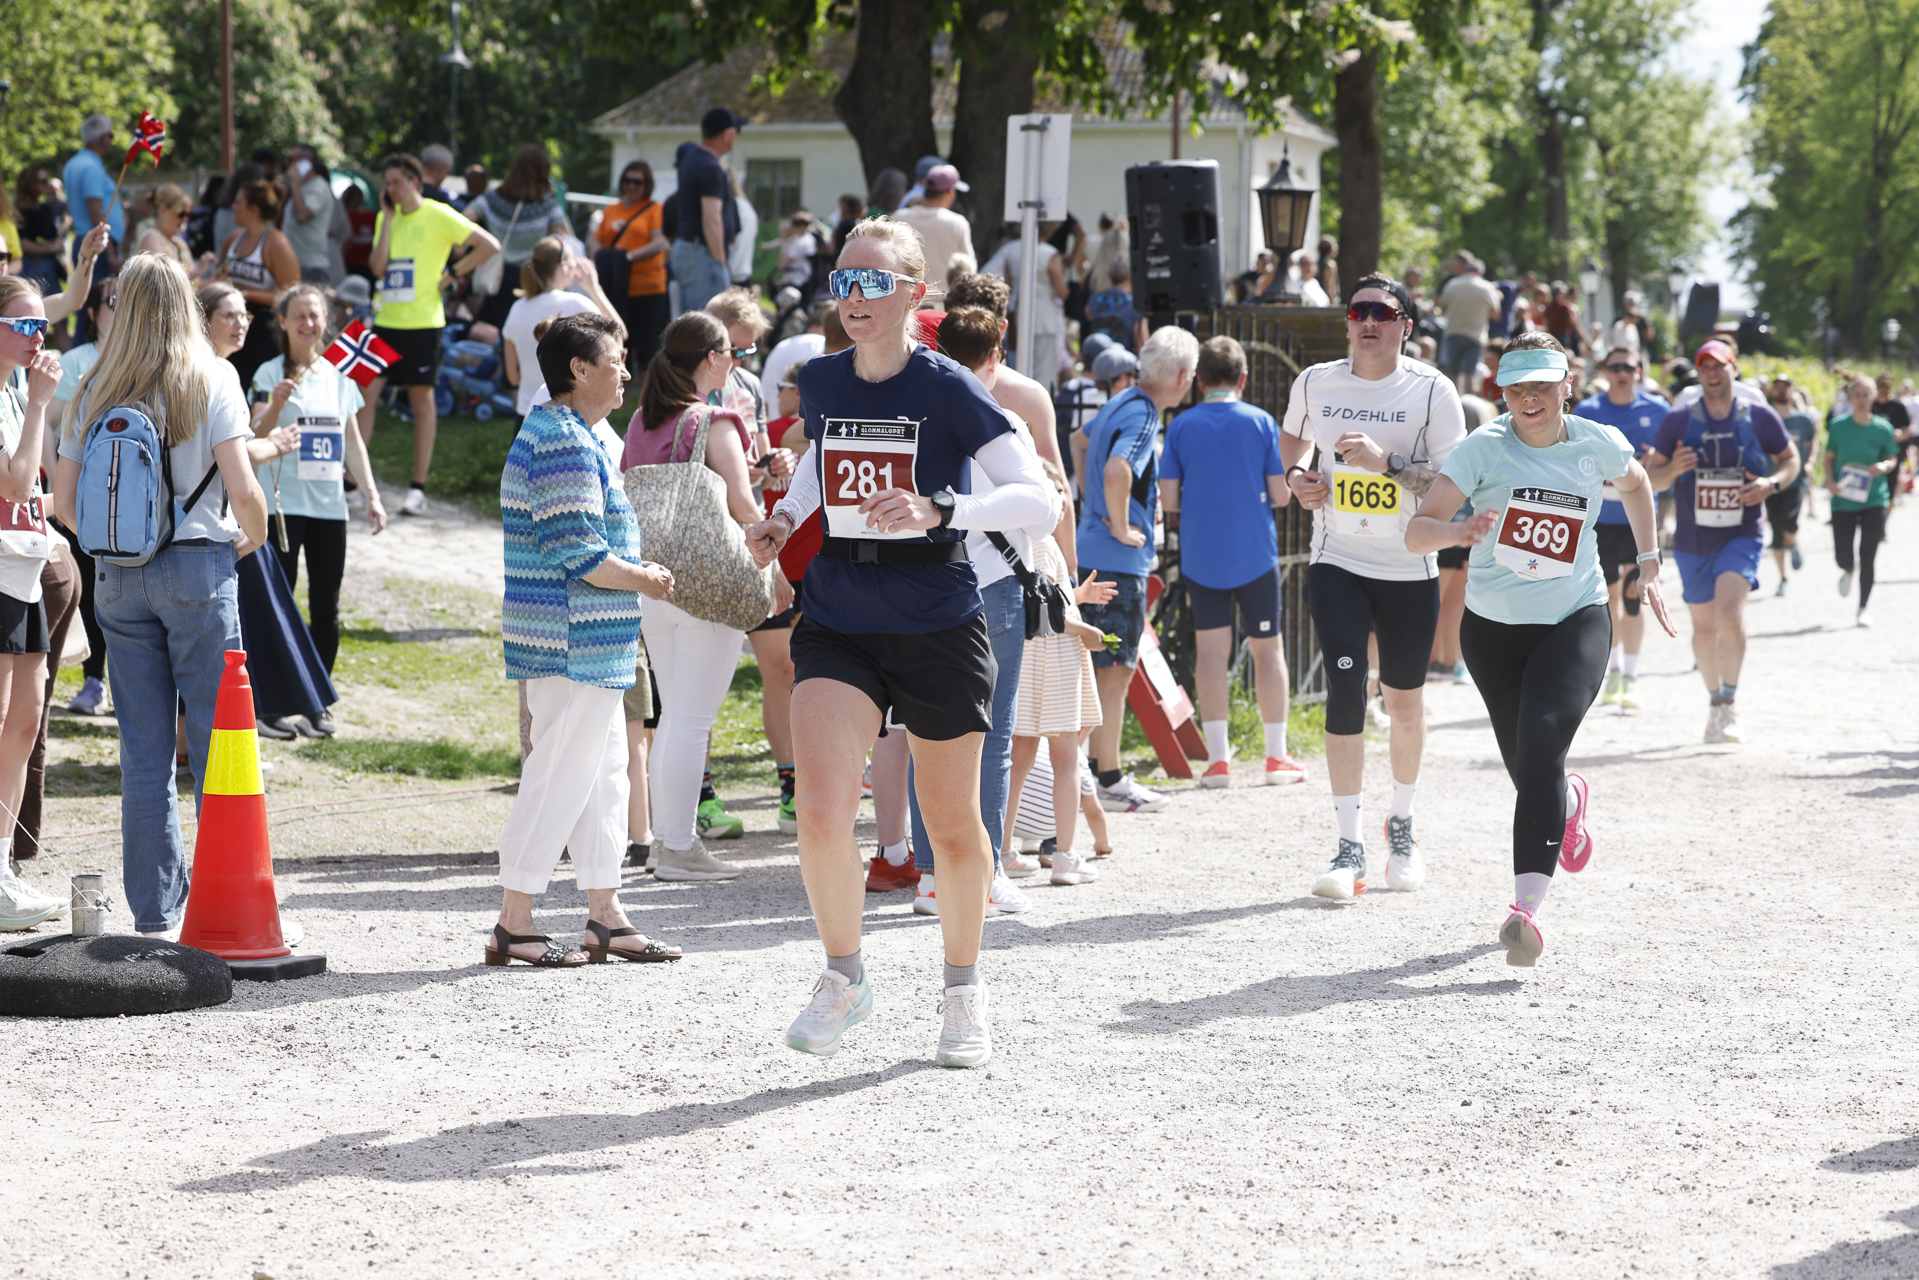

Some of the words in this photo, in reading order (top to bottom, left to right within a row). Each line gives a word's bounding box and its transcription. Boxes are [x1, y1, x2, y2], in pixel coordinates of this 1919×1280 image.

[312, 437, 333, 459] 50
[837, 459, 893, 499] 281
[1337, 479, 1396, 509] 1663
[1700, 488, 1740, 509] 1152
[1512, 516, 1569, 554] 369
